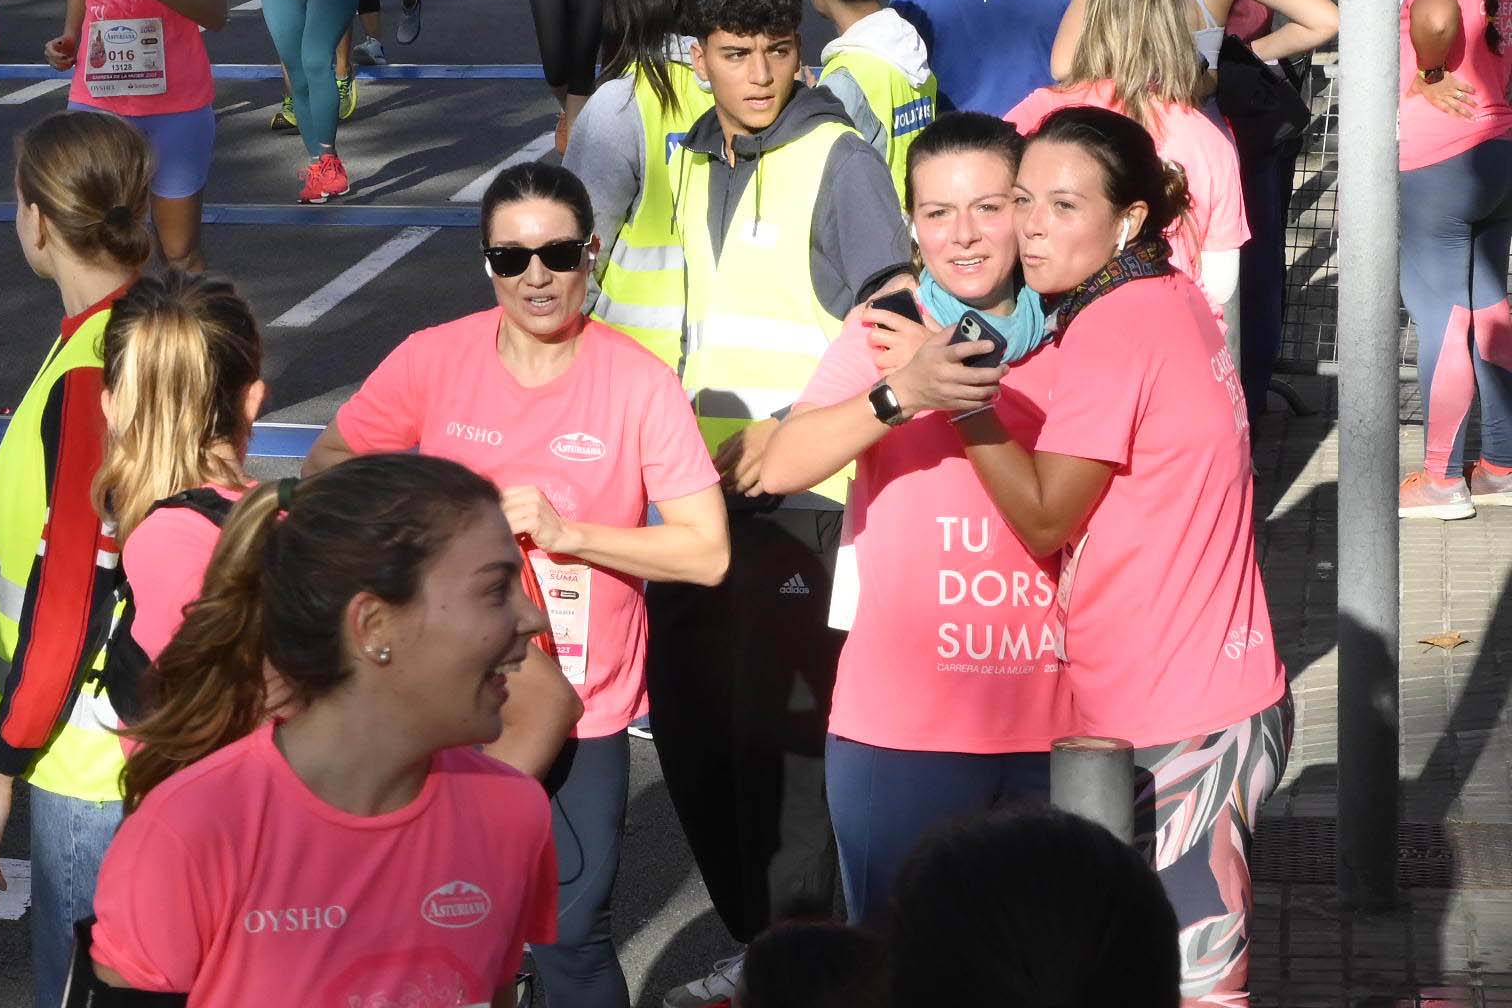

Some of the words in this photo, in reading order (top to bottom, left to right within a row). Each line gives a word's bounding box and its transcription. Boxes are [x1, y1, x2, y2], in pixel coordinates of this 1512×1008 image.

[108, 50, 135, 61] 016
[446, 421, 503, 446] OYSHO
[935, 516, 990, 554] TU
[550, 574, 579, 583] SUMA
[779, 585, 810, 594] adidas
[938, 570, 1055, 607] DORS
[936, 622, 1058, 660] SUMA
[937, 663, 979, 672] CARRERA
[981, 665, 994, 674] DE
[995, 666, 1005, 674] LA
[243, 904, 348, 934] OYSHO
